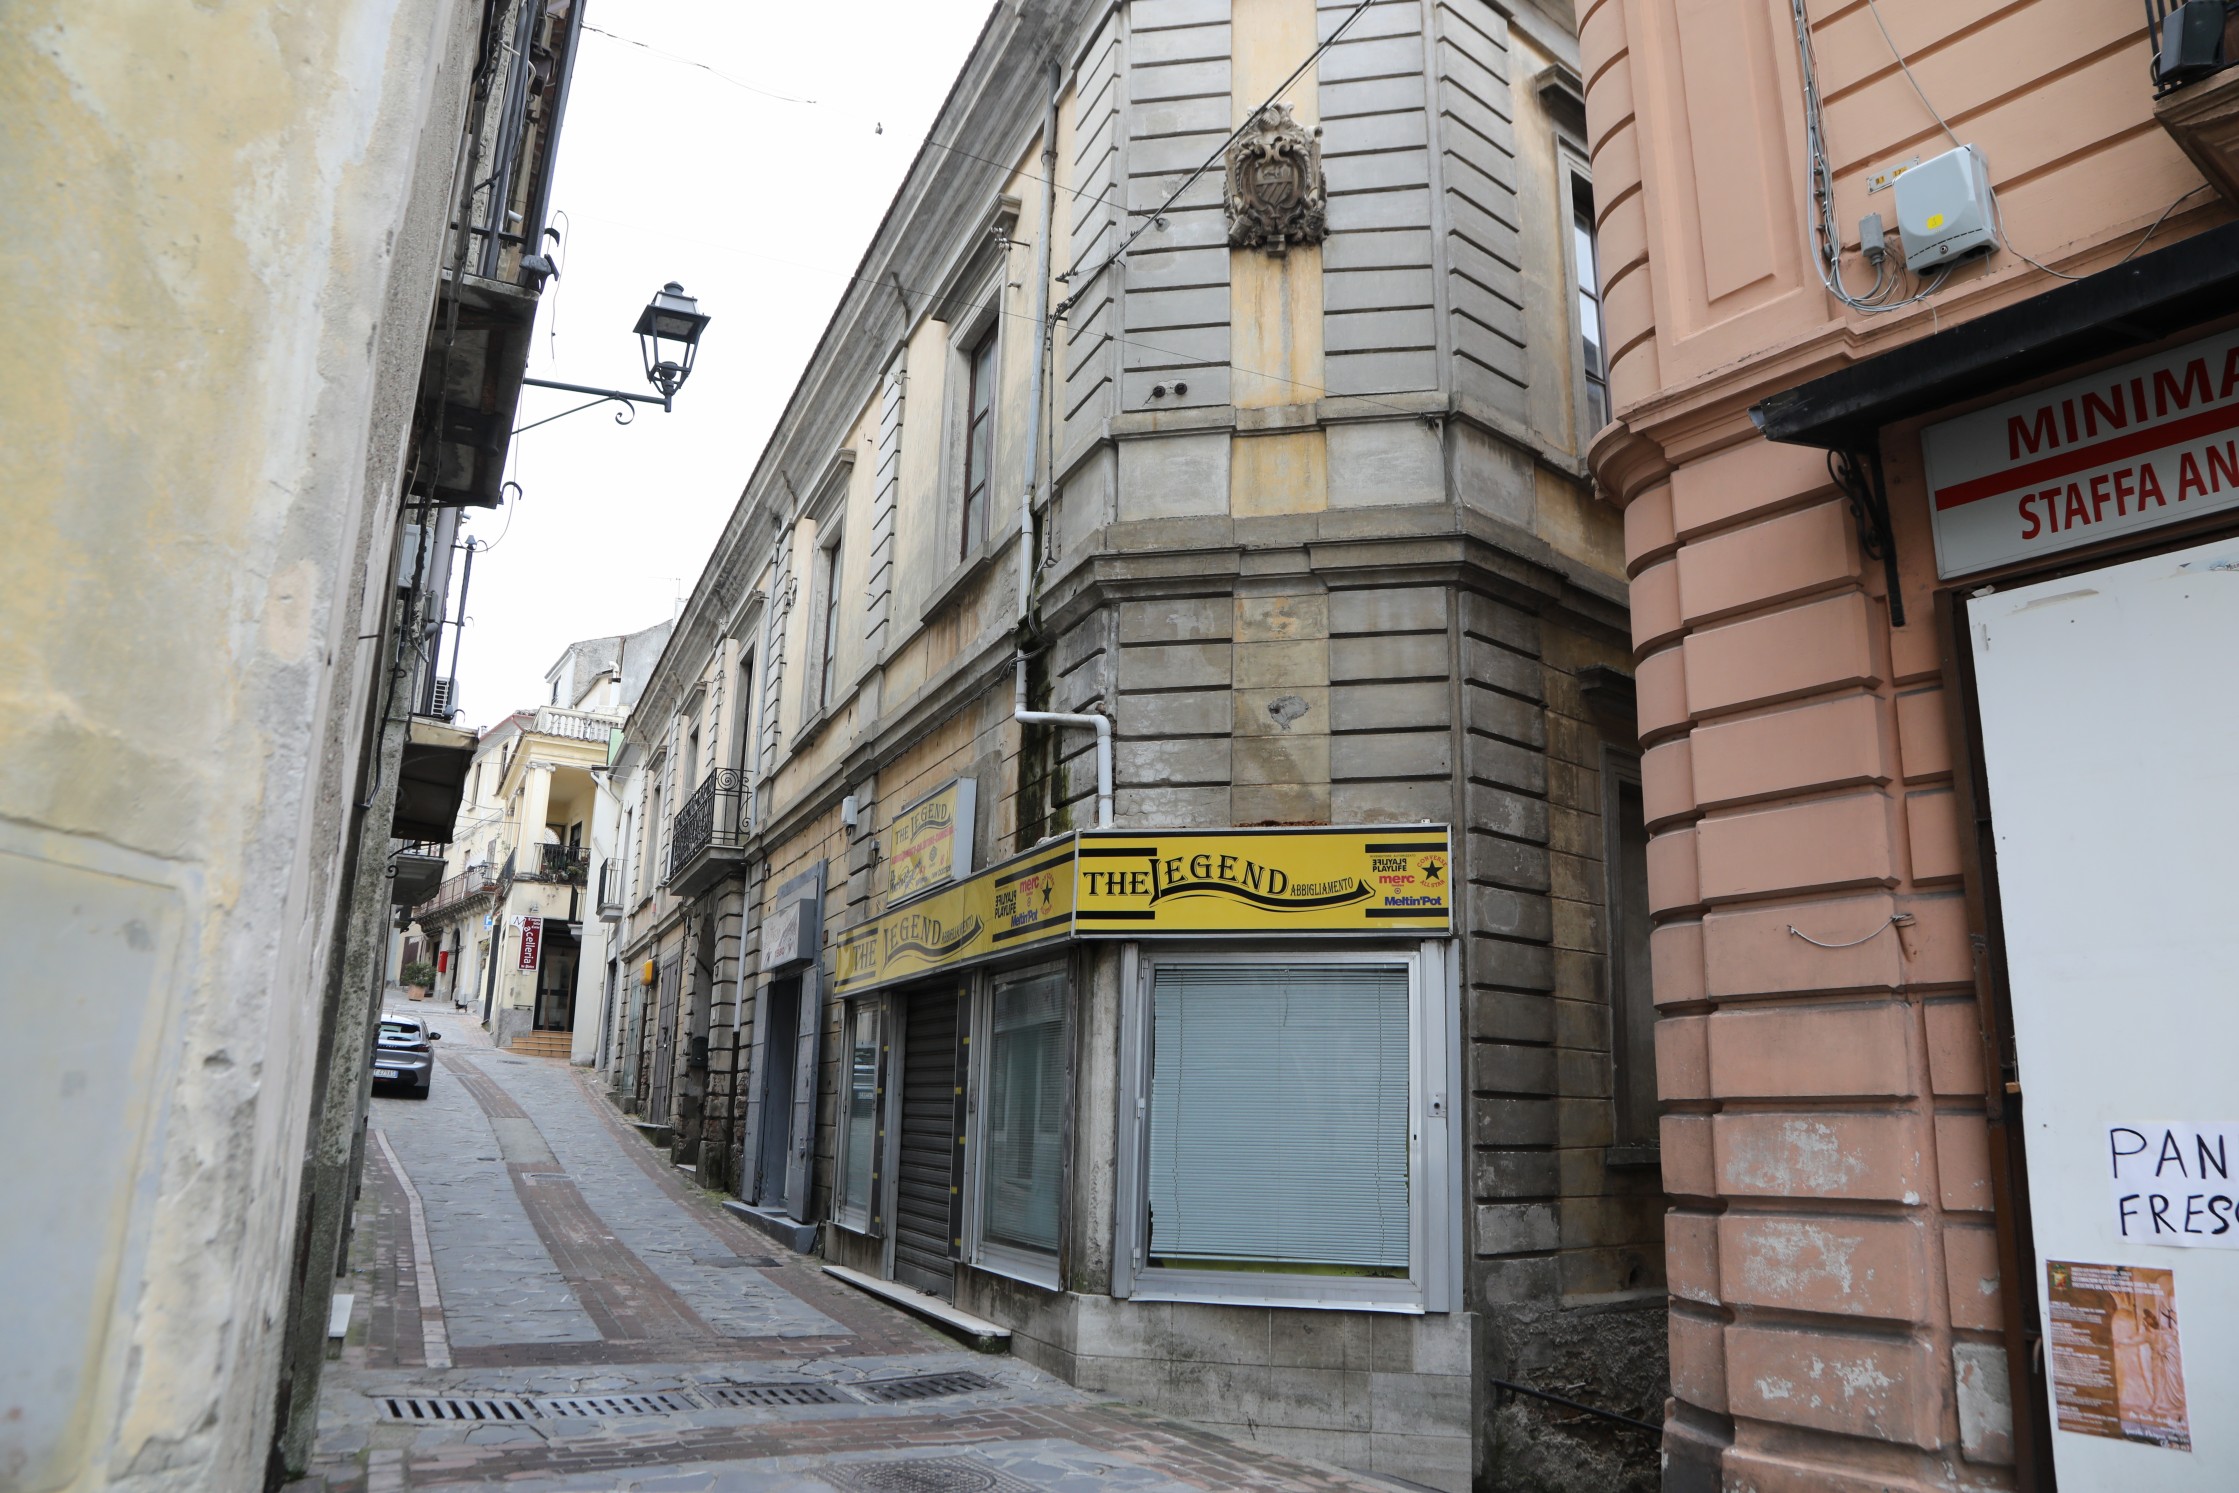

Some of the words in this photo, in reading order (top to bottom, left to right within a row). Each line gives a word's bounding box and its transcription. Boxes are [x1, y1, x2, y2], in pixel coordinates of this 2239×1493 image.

[2018, 463, 2167, 540] STAFFA
[2178, 440, 2239, 502] AN
[896, 826, 909, 845] THE
[911, 803, 947, 842] LEGEND
[1083, 871, 1151, 898] THE
[1148, 854, 1288, 905] LEGEND
[1290, 877, 1353, 897] ABBIGLIAMENTO
[1379, 875, 1415, 884] merc
[1417, 854, 1448, 868] CONVERSE
[1020, 876, 1040, 894] merc
[853, 939, 877, 971] THE
[883, 914, 941, 966] LEGEND
[2120, 1194, 2239, 1236] FRES
